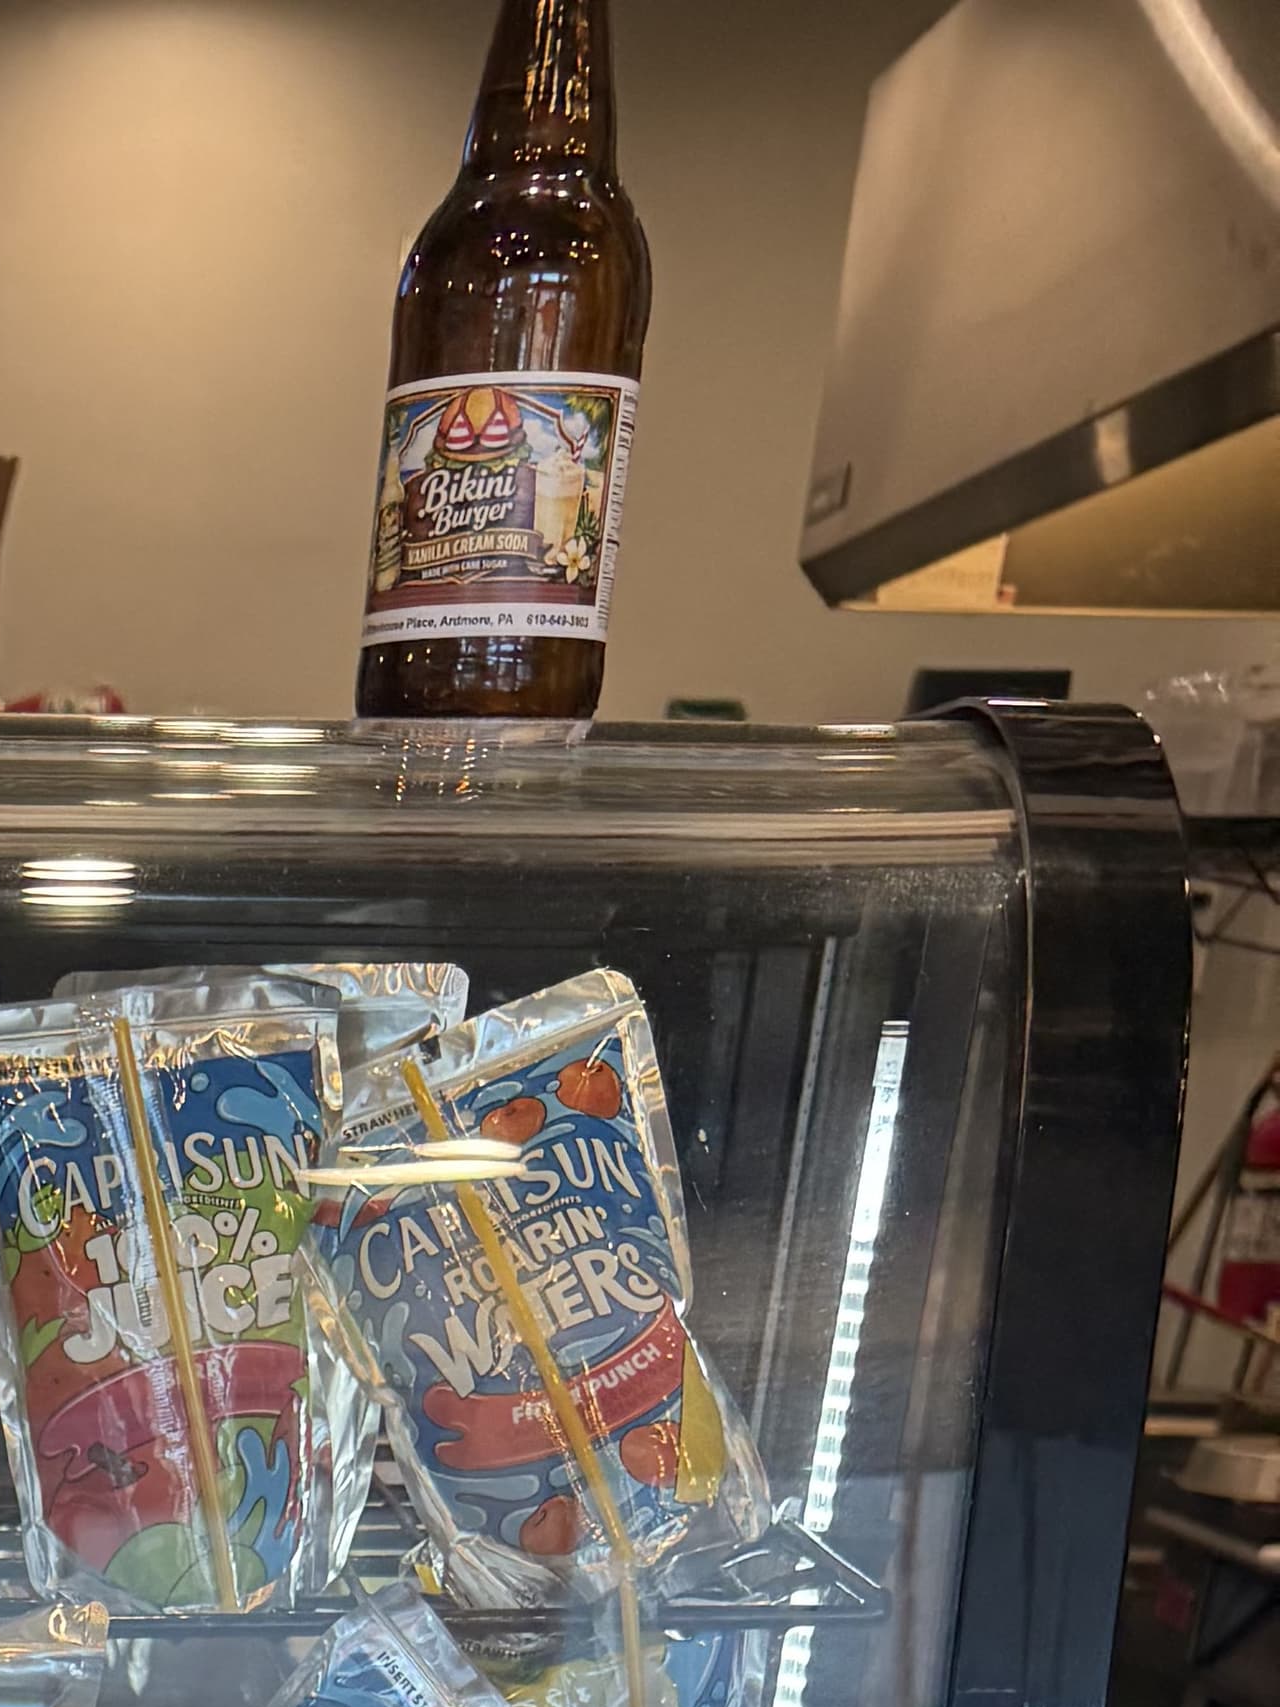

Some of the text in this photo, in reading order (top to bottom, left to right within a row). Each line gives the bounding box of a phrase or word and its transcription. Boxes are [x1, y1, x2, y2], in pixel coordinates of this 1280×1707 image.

[418, 466, 517, 519] Bikini
[428, 500, 513, 538] Burger
[408, 535, 529, 565] VANILLA CREAM SODA
[497, 614, 514, 625] PA
[342, 1112, 391, 1140] STRAW
[18, 1132, 313, 1238] CAPI SUN
[517, 1138, 641, 1205] SUN
[589, 1343, 662, 1398] PUNCH
